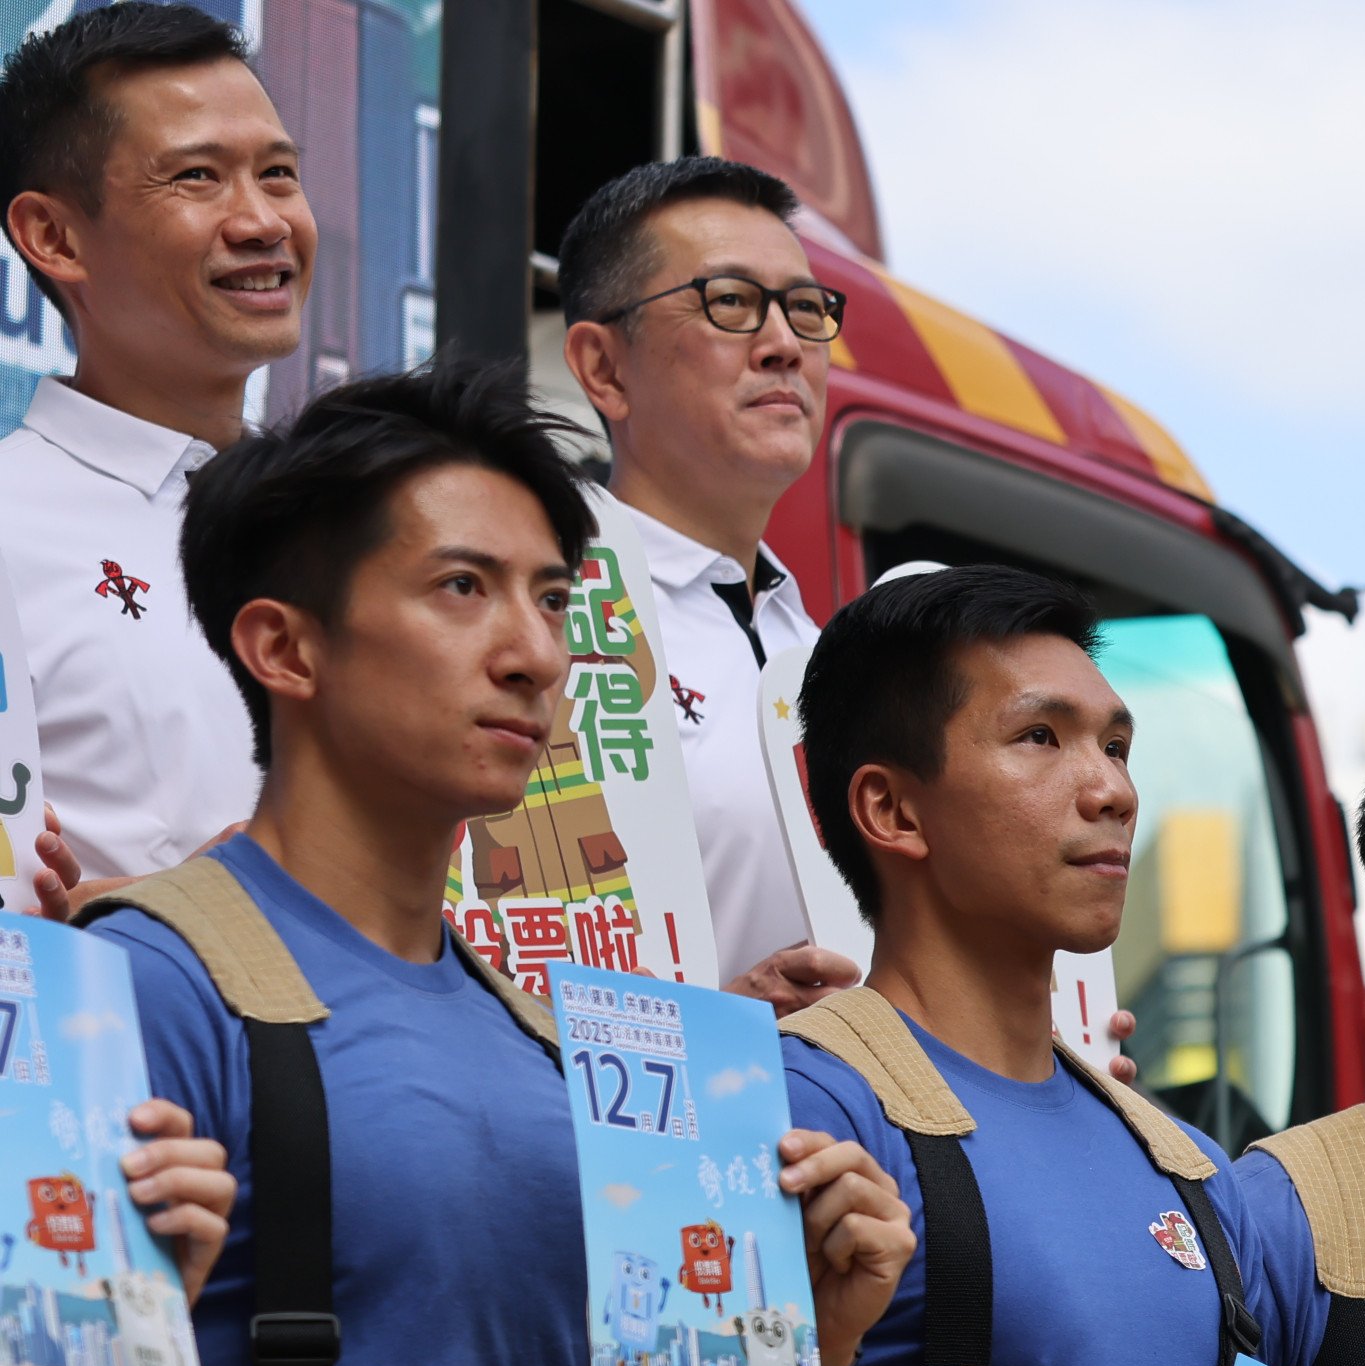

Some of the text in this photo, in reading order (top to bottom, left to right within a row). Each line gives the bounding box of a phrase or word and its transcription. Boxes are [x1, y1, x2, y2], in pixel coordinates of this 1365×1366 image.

[565, 546, 654, 782] 記得
[561, 984, 617, 1008] 投入選舉
[625, 994, 680, 1019] 共創未來
